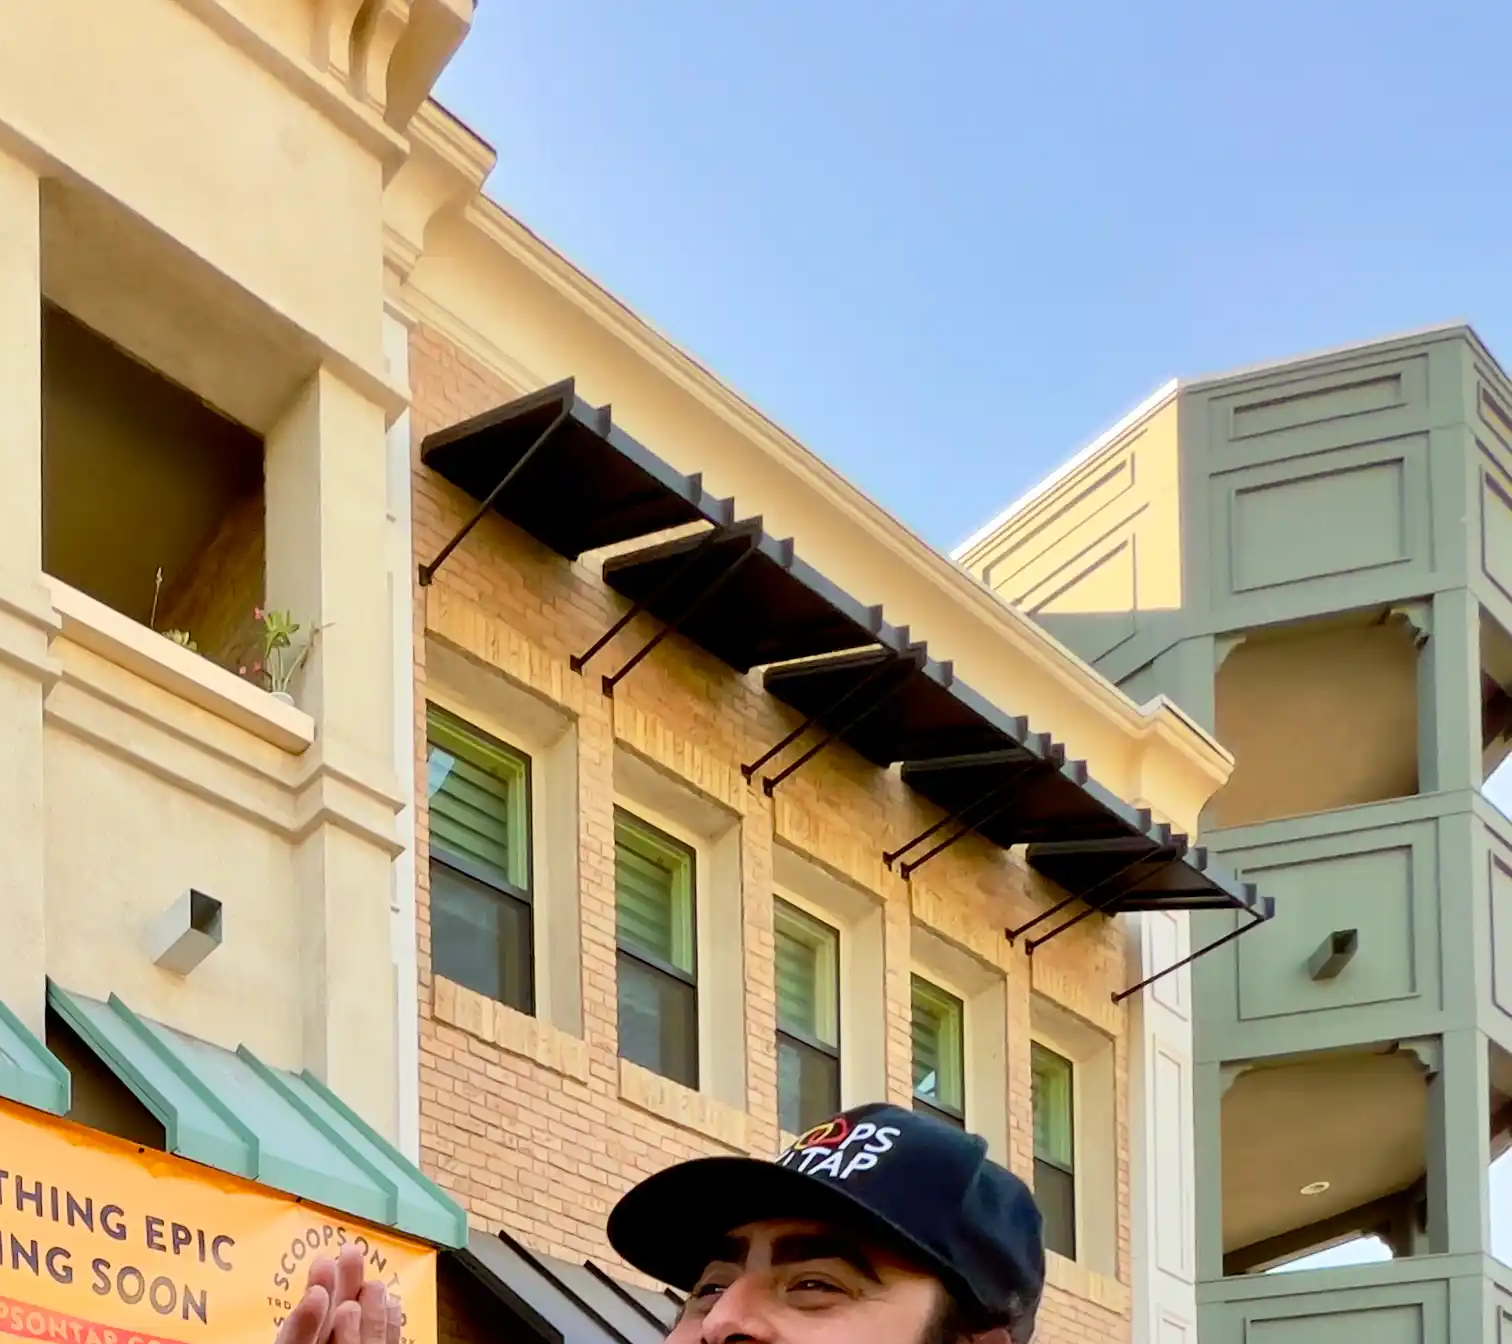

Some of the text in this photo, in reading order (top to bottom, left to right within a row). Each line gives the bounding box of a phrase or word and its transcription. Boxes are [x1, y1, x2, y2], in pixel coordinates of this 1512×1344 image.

[794, 1118, 901, 1153] OOPS
[798, 1146, 878, 1179] TAP
[145, 1215, 236, 1271] EPIC
[274, 1225, 348, 1291] SCOOPS
[92, 1258, 208, 1325] SOON
